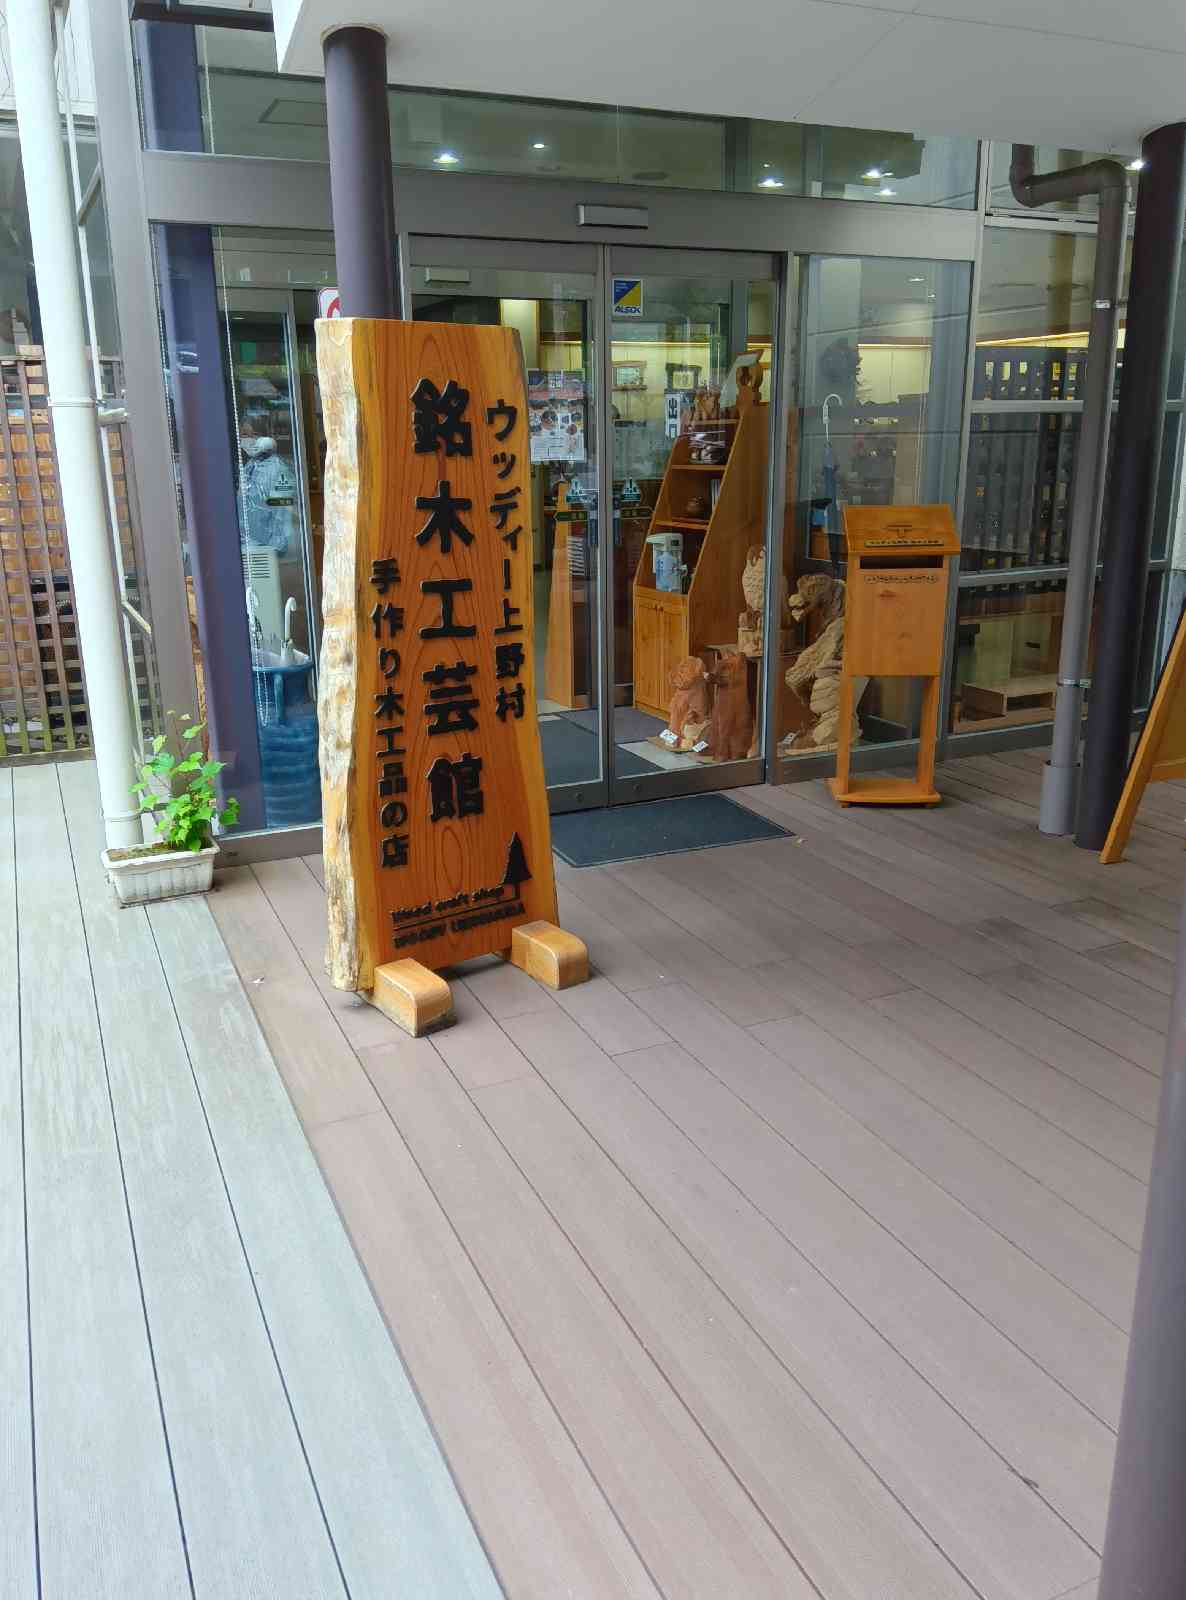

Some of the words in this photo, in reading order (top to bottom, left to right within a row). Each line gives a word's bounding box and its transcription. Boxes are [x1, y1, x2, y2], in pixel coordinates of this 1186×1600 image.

[369, 557, 409, 868] 手作り木工品の店
[410, 377, 484, 821] 銘木工芸館
[485, 398, 526, 722] ウッディー上野村
